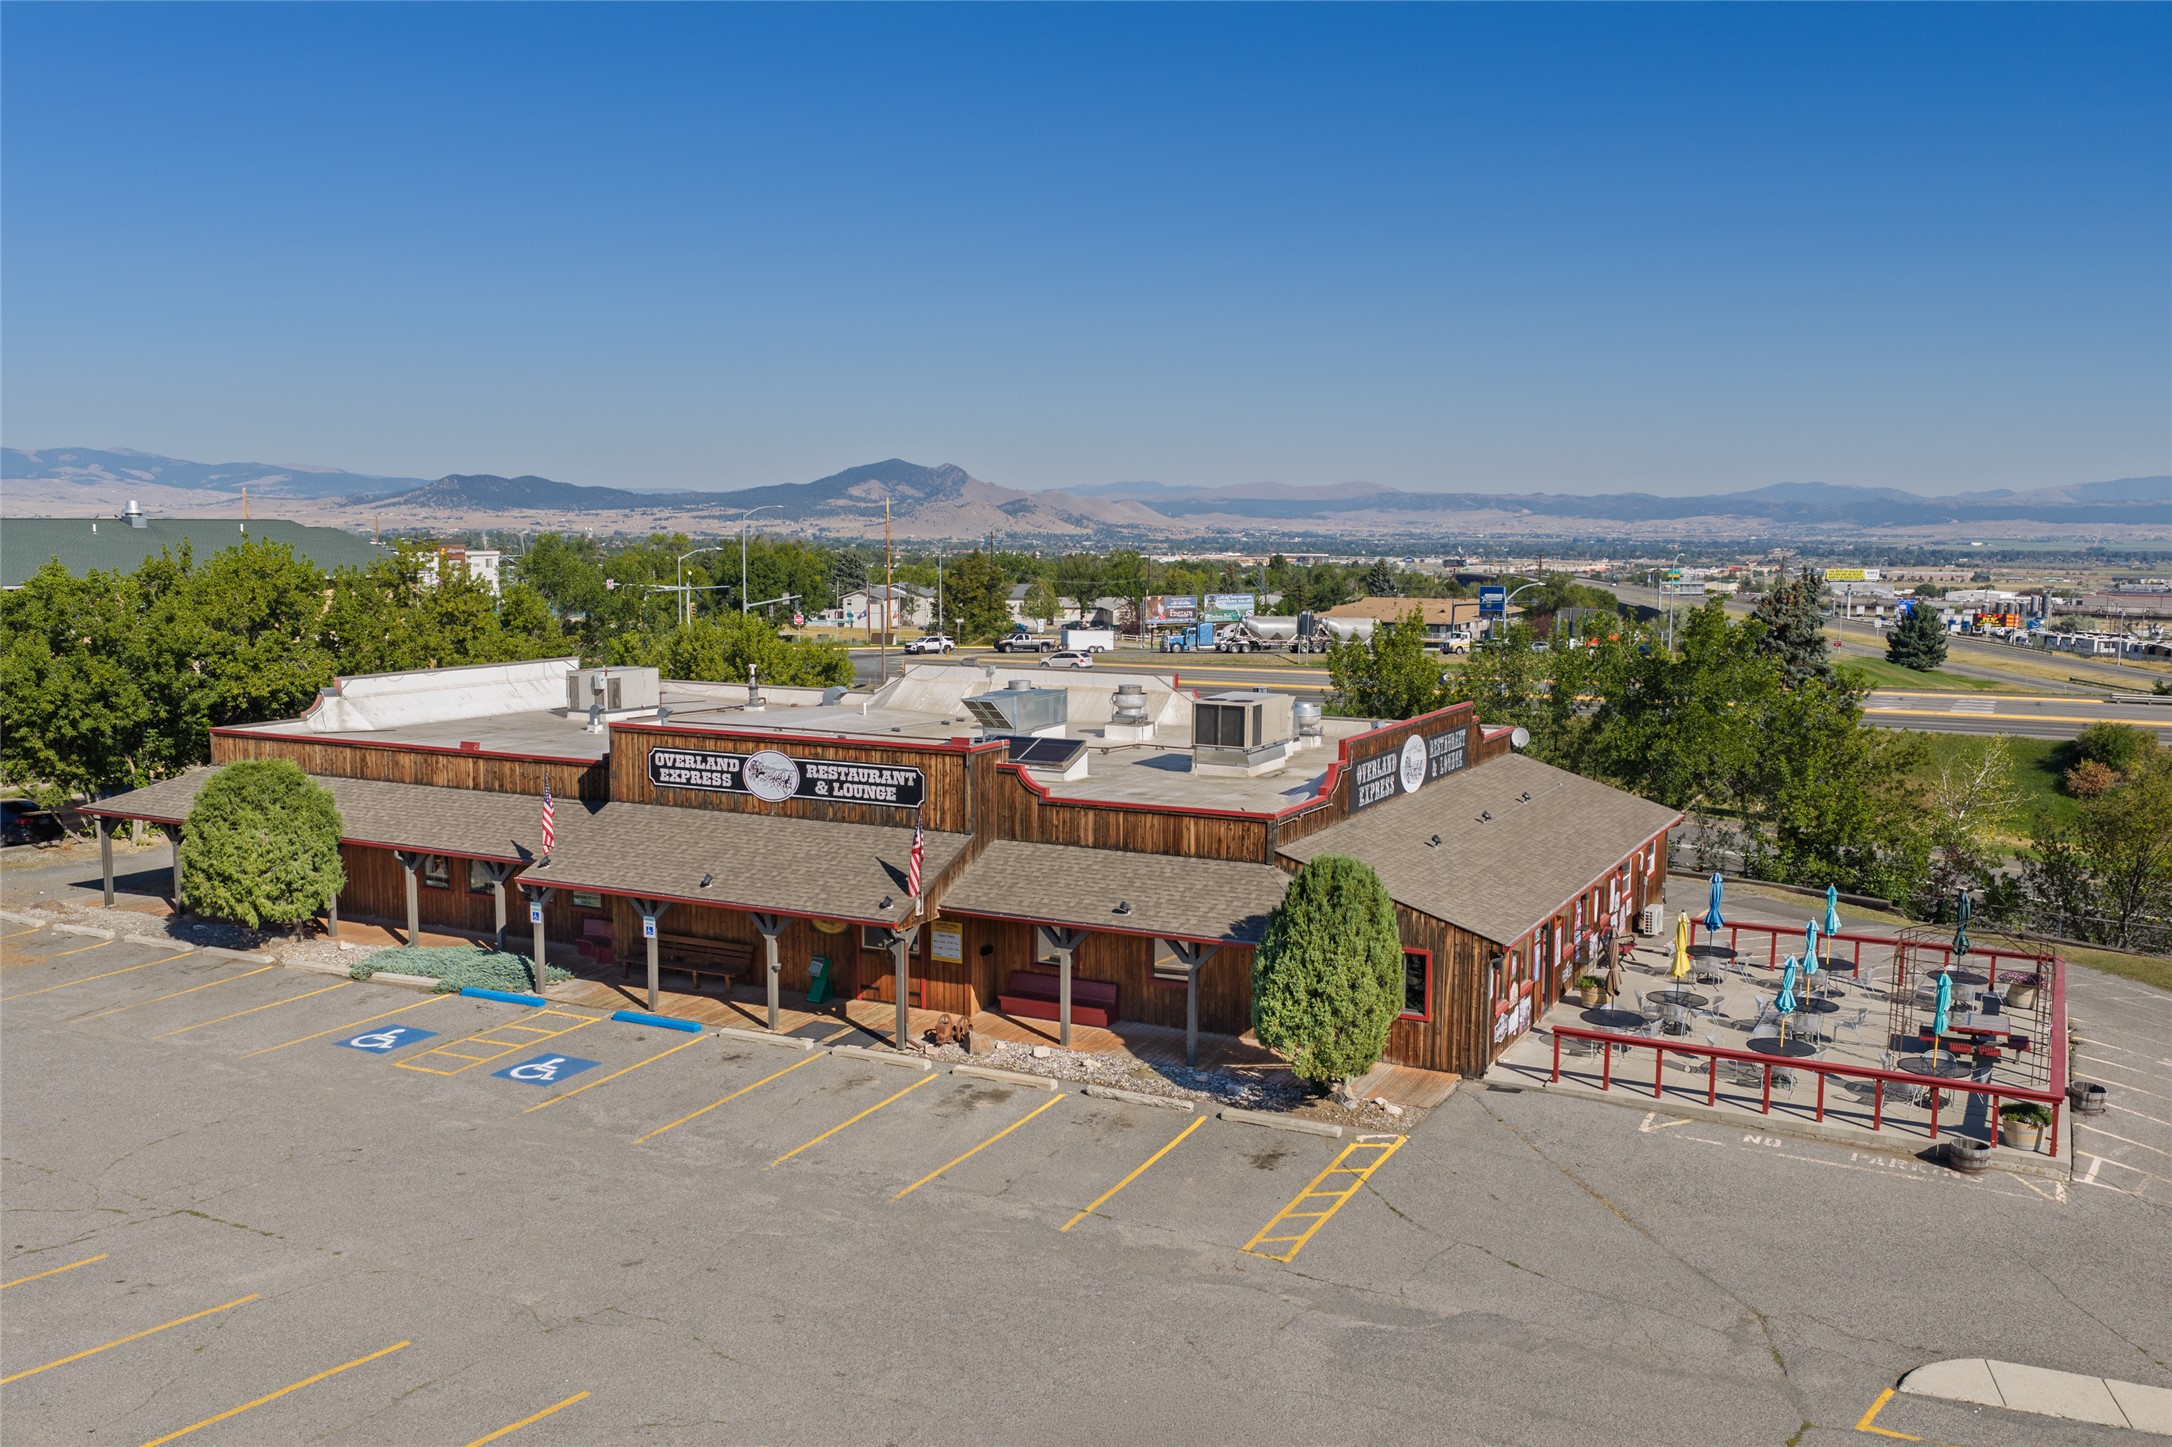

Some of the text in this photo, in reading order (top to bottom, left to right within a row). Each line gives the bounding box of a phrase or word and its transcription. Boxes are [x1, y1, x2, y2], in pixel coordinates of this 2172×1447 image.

[654, 752, 740, 771] OVERLAND
[1356, 752, 1397, 786] OVERLAND
[659, 768, 732, 787] EXPRESS
[806, 764, 917, 787] RESTAURANT
[814, 780, 897, 801] & LOUNGE
[1358, 774, 1395, 807] EXPRESS
[1743, 1133, 1783, 1148] NO
